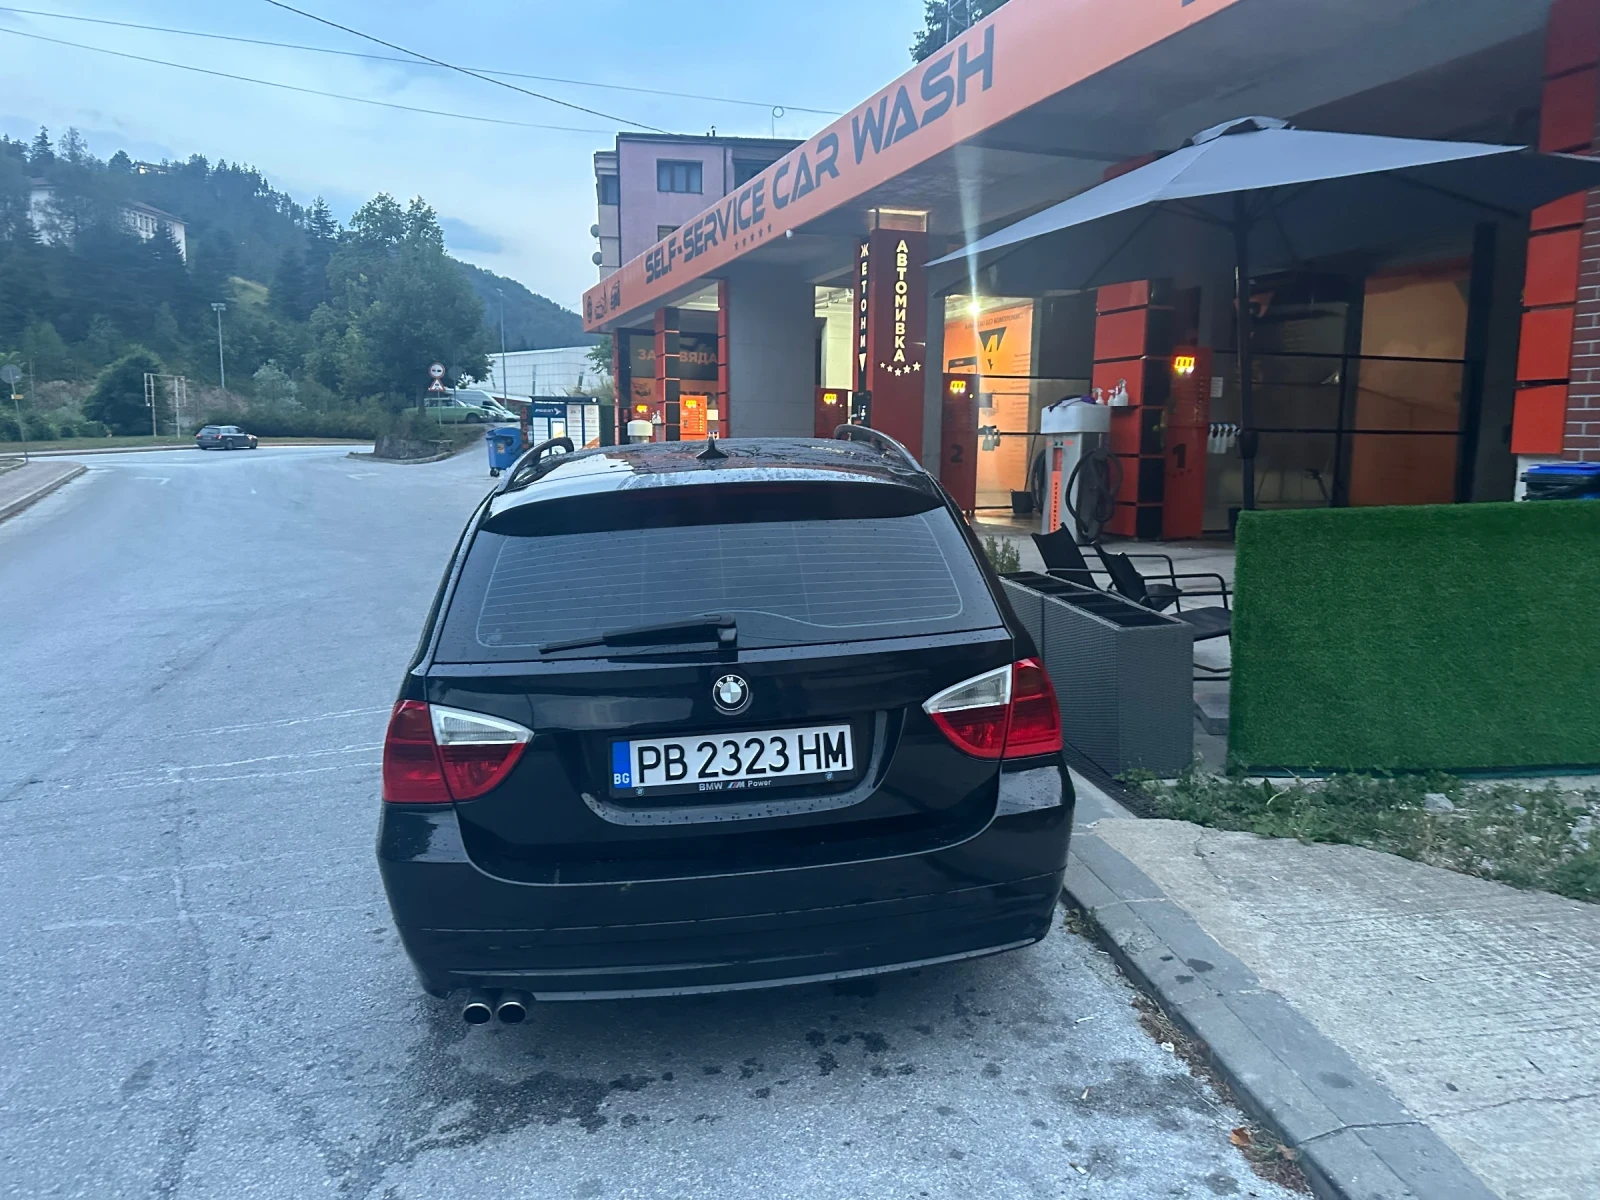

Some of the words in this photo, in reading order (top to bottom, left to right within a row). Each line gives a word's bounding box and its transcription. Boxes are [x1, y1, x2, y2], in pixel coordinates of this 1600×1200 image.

[645, 178, 765, 284] SELF-SERVICE
[772, 132, 839, 208] CAR
[852, 24, 995, 165] WASH
[860, 242, 869, 348] ЖЕТОНИ
[893, 239, 909, 363] АВТОМИВКА
[950, 443, 963, 463] 2
[1172, 443, 1187, 469] 1
[637, 743, 688, 784] PB
[697, 736, 790, 779] 2323
[797, 731, 848, 771] HM
[613, 773, 630, 785] BG
[698, 782, 723, 791] BMW
[747, 780, 772, 788] Power
